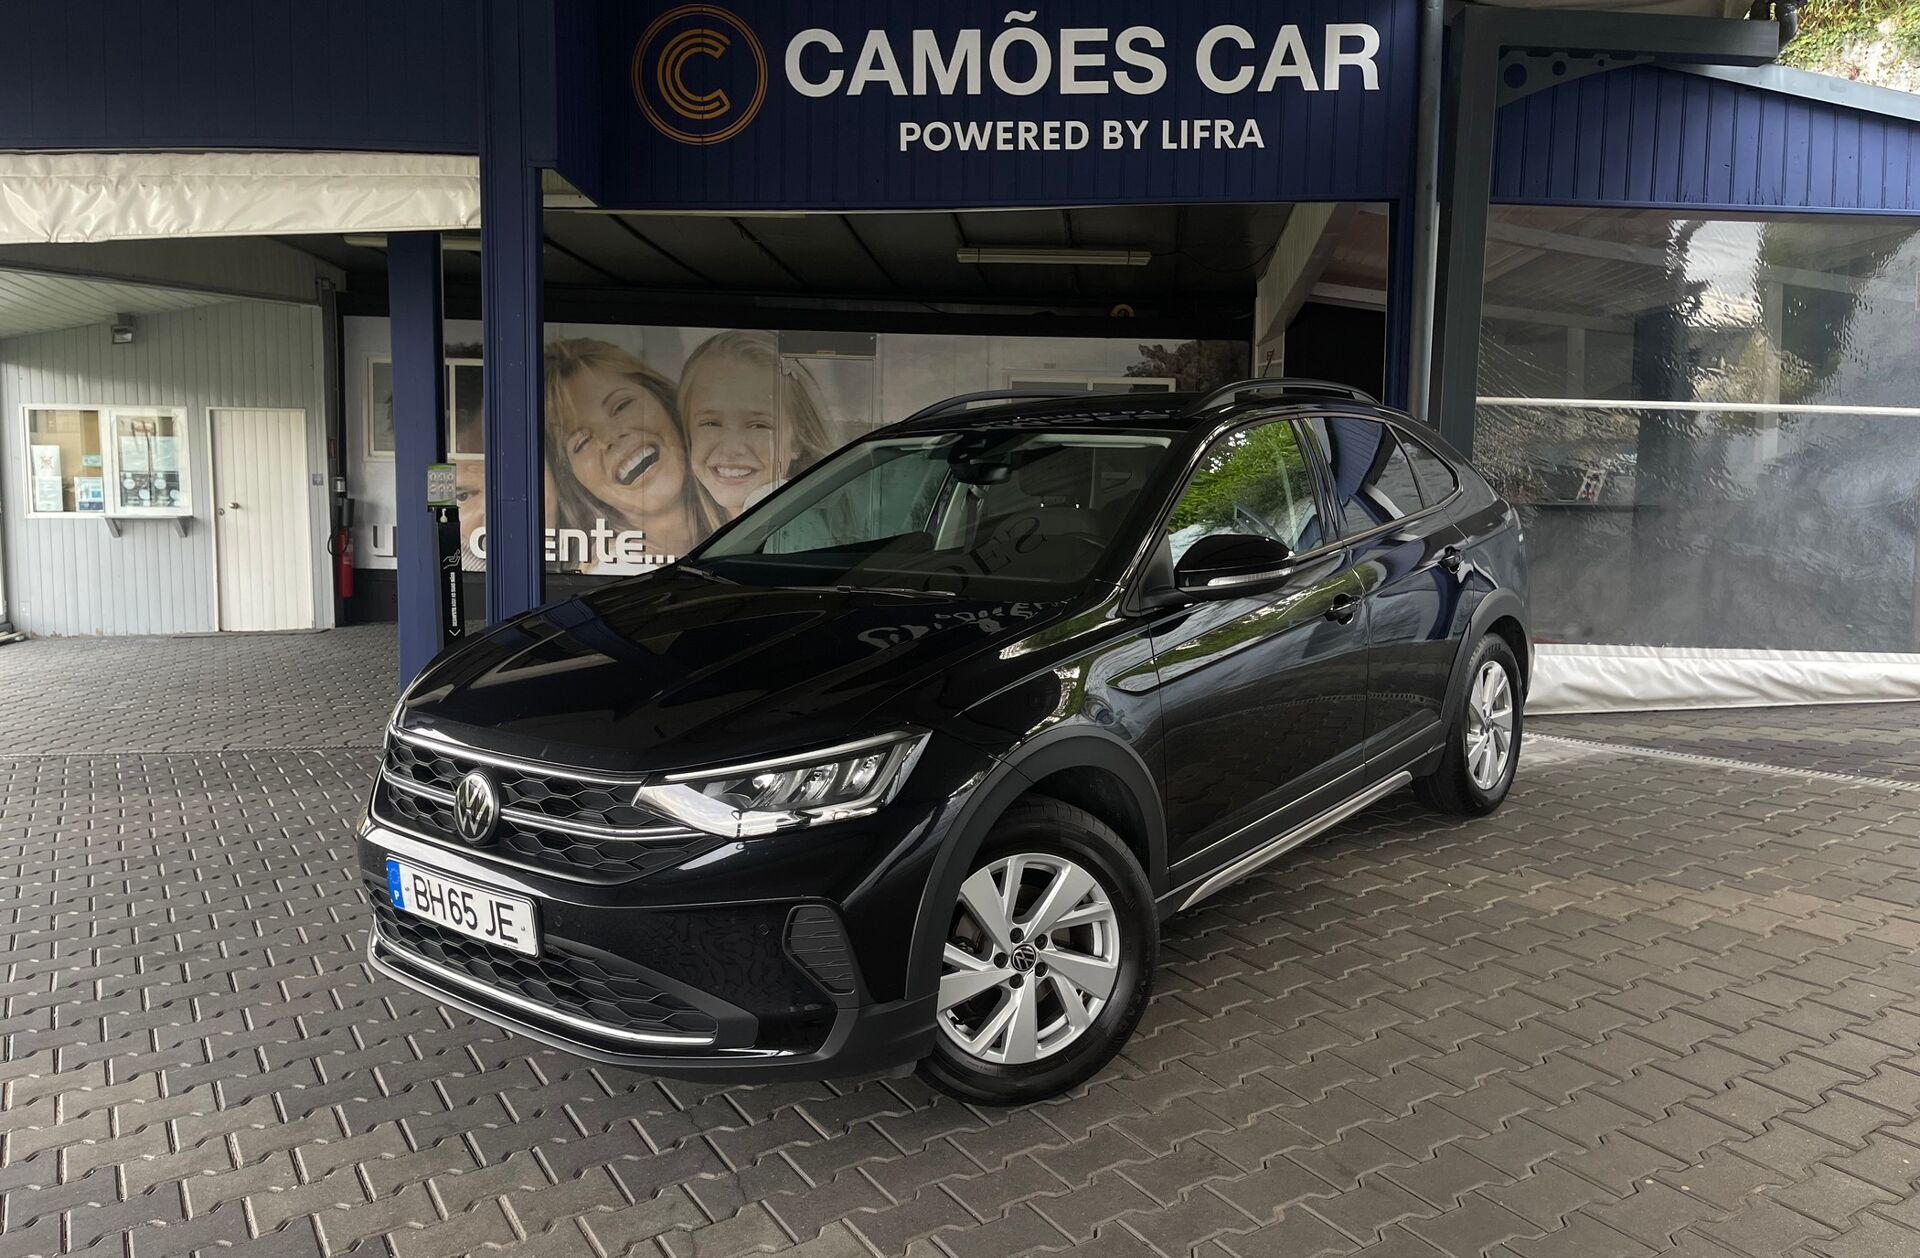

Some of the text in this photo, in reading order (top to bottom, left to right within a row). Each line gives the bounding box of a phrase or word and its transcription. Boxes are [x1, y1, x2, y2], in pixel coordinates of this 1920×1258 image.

[785, 10, 1380, 98] CAMÕES CAR
[899, 118, 1265, 152] POWERED BY LIFRA
[393, 889, 400, 900] P
